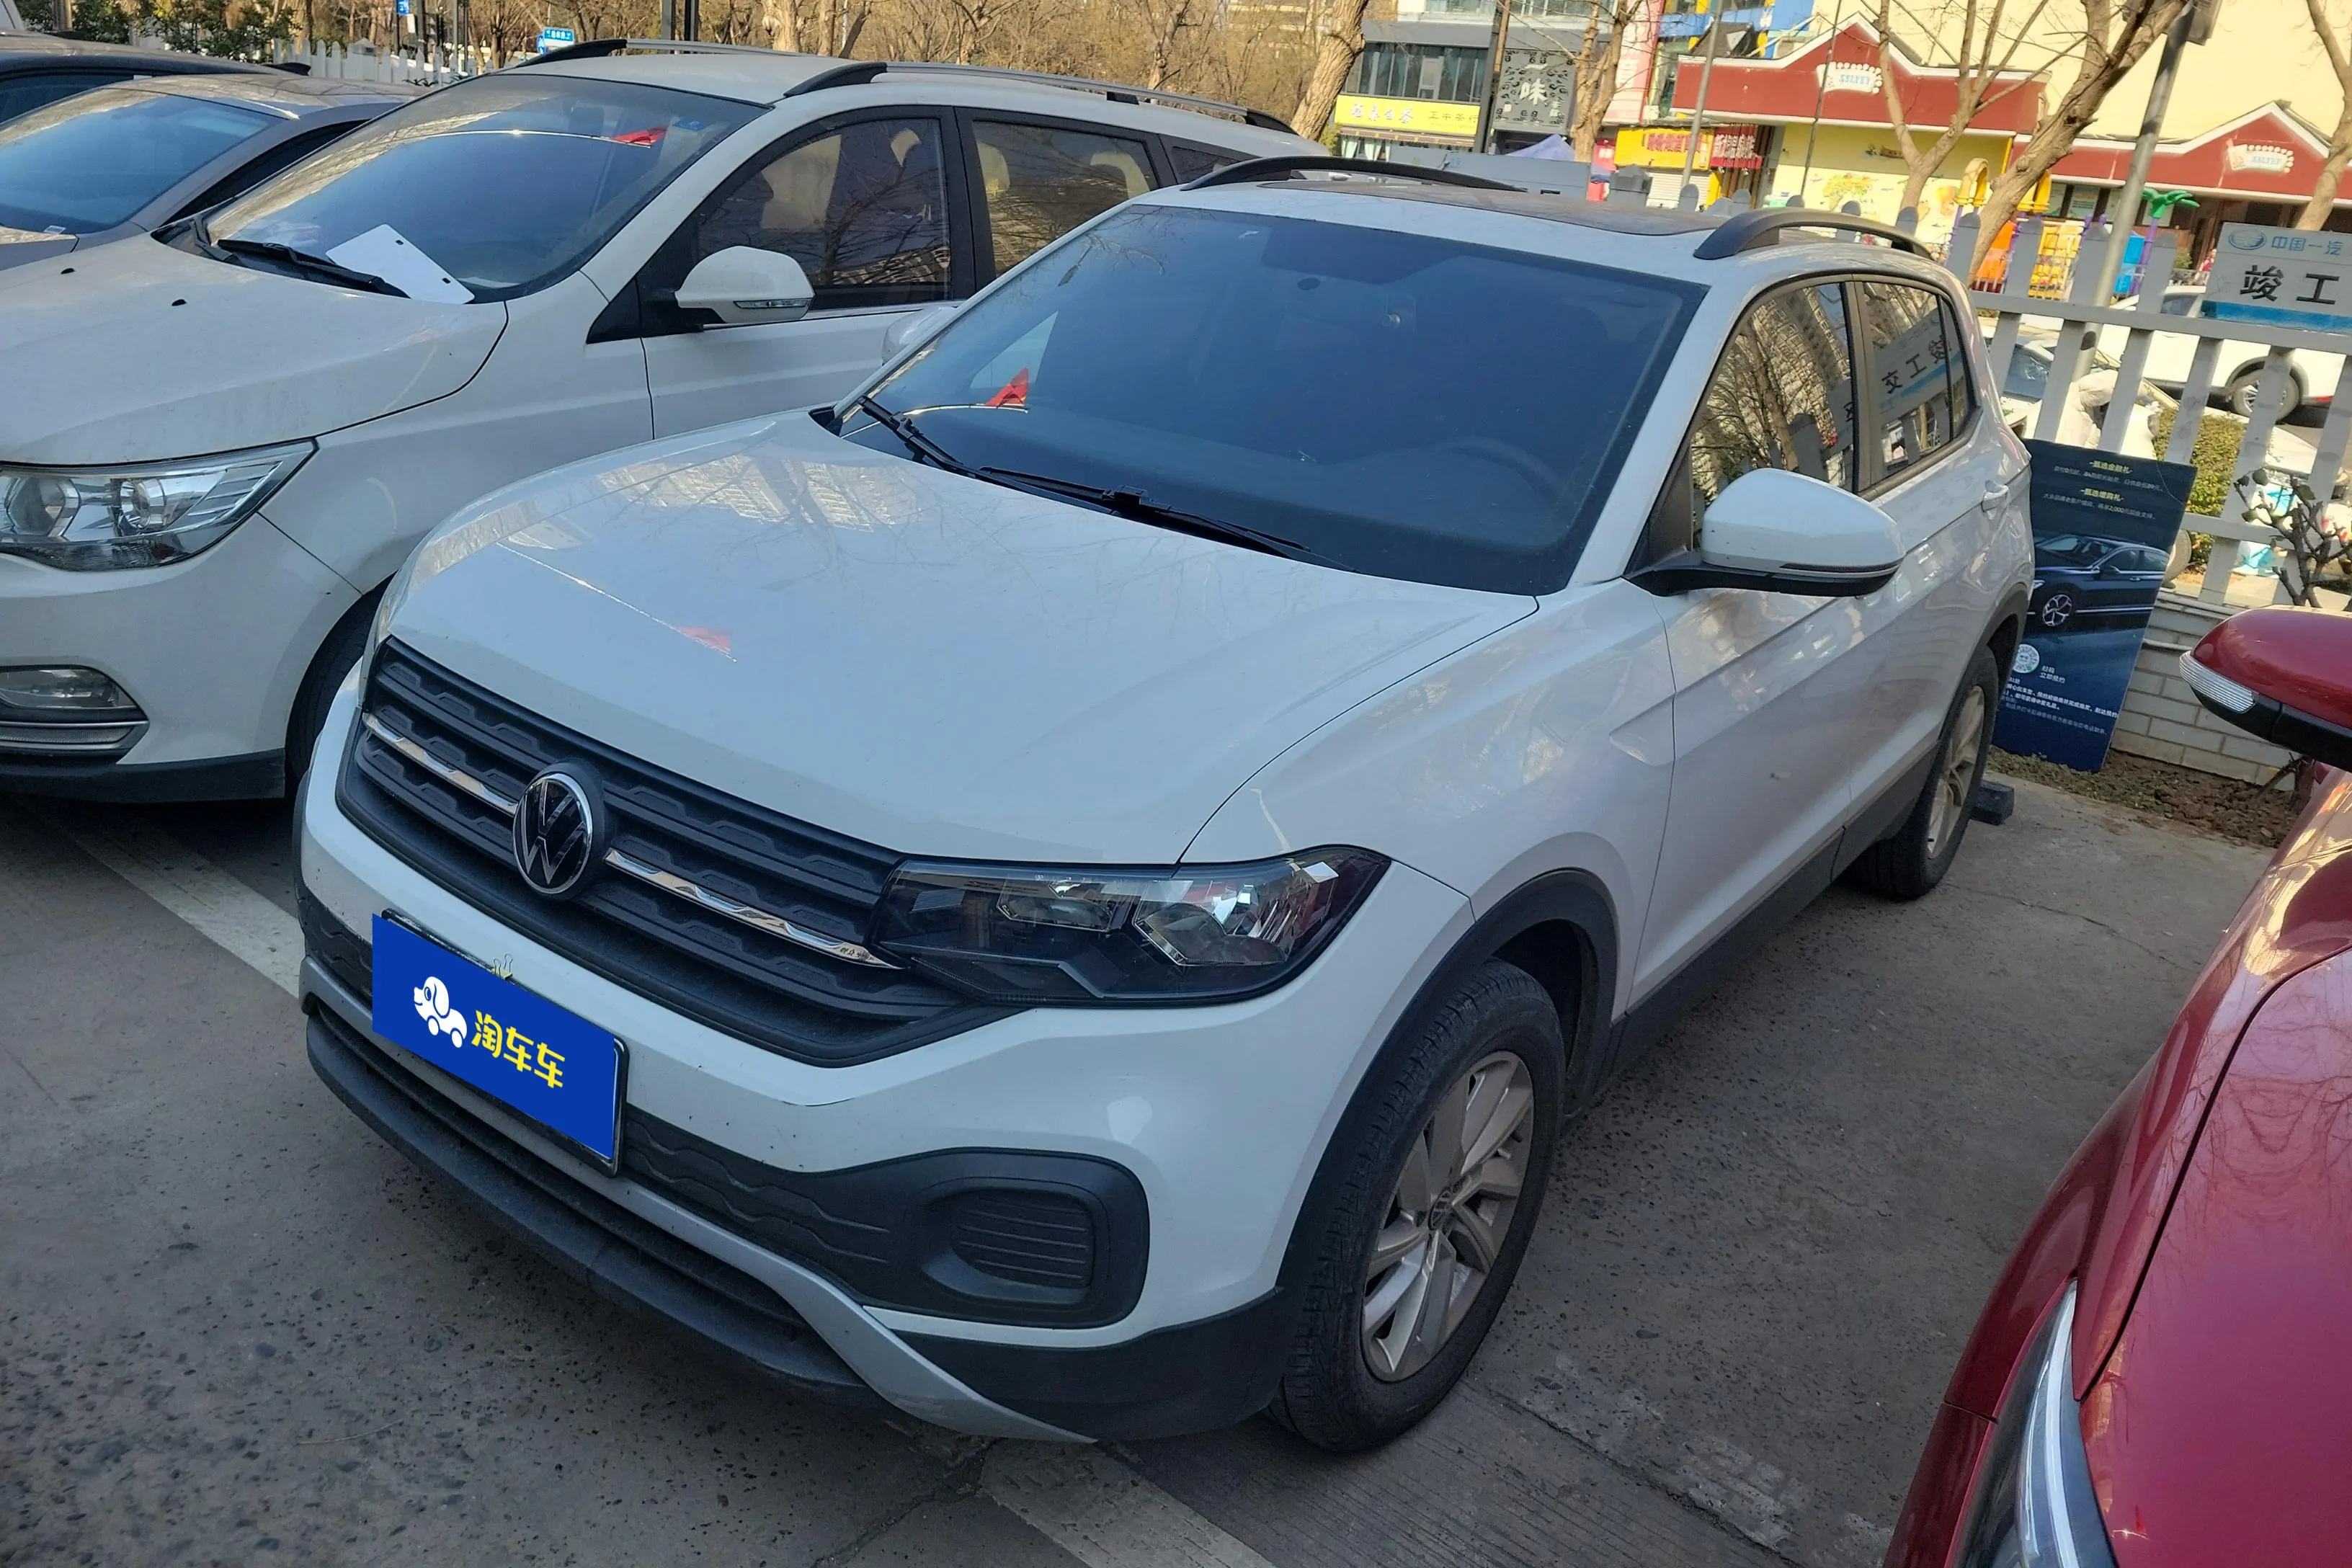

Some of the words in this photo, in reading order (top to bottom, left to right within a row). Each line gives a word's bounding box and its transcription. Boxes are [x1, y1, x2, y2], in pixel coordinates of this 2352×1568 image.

[1519, 63, 1549, 107] 一味
[2271, 236, 2343, 256] 中国一汽
[2240, 264, 2340, 305] 竣工
